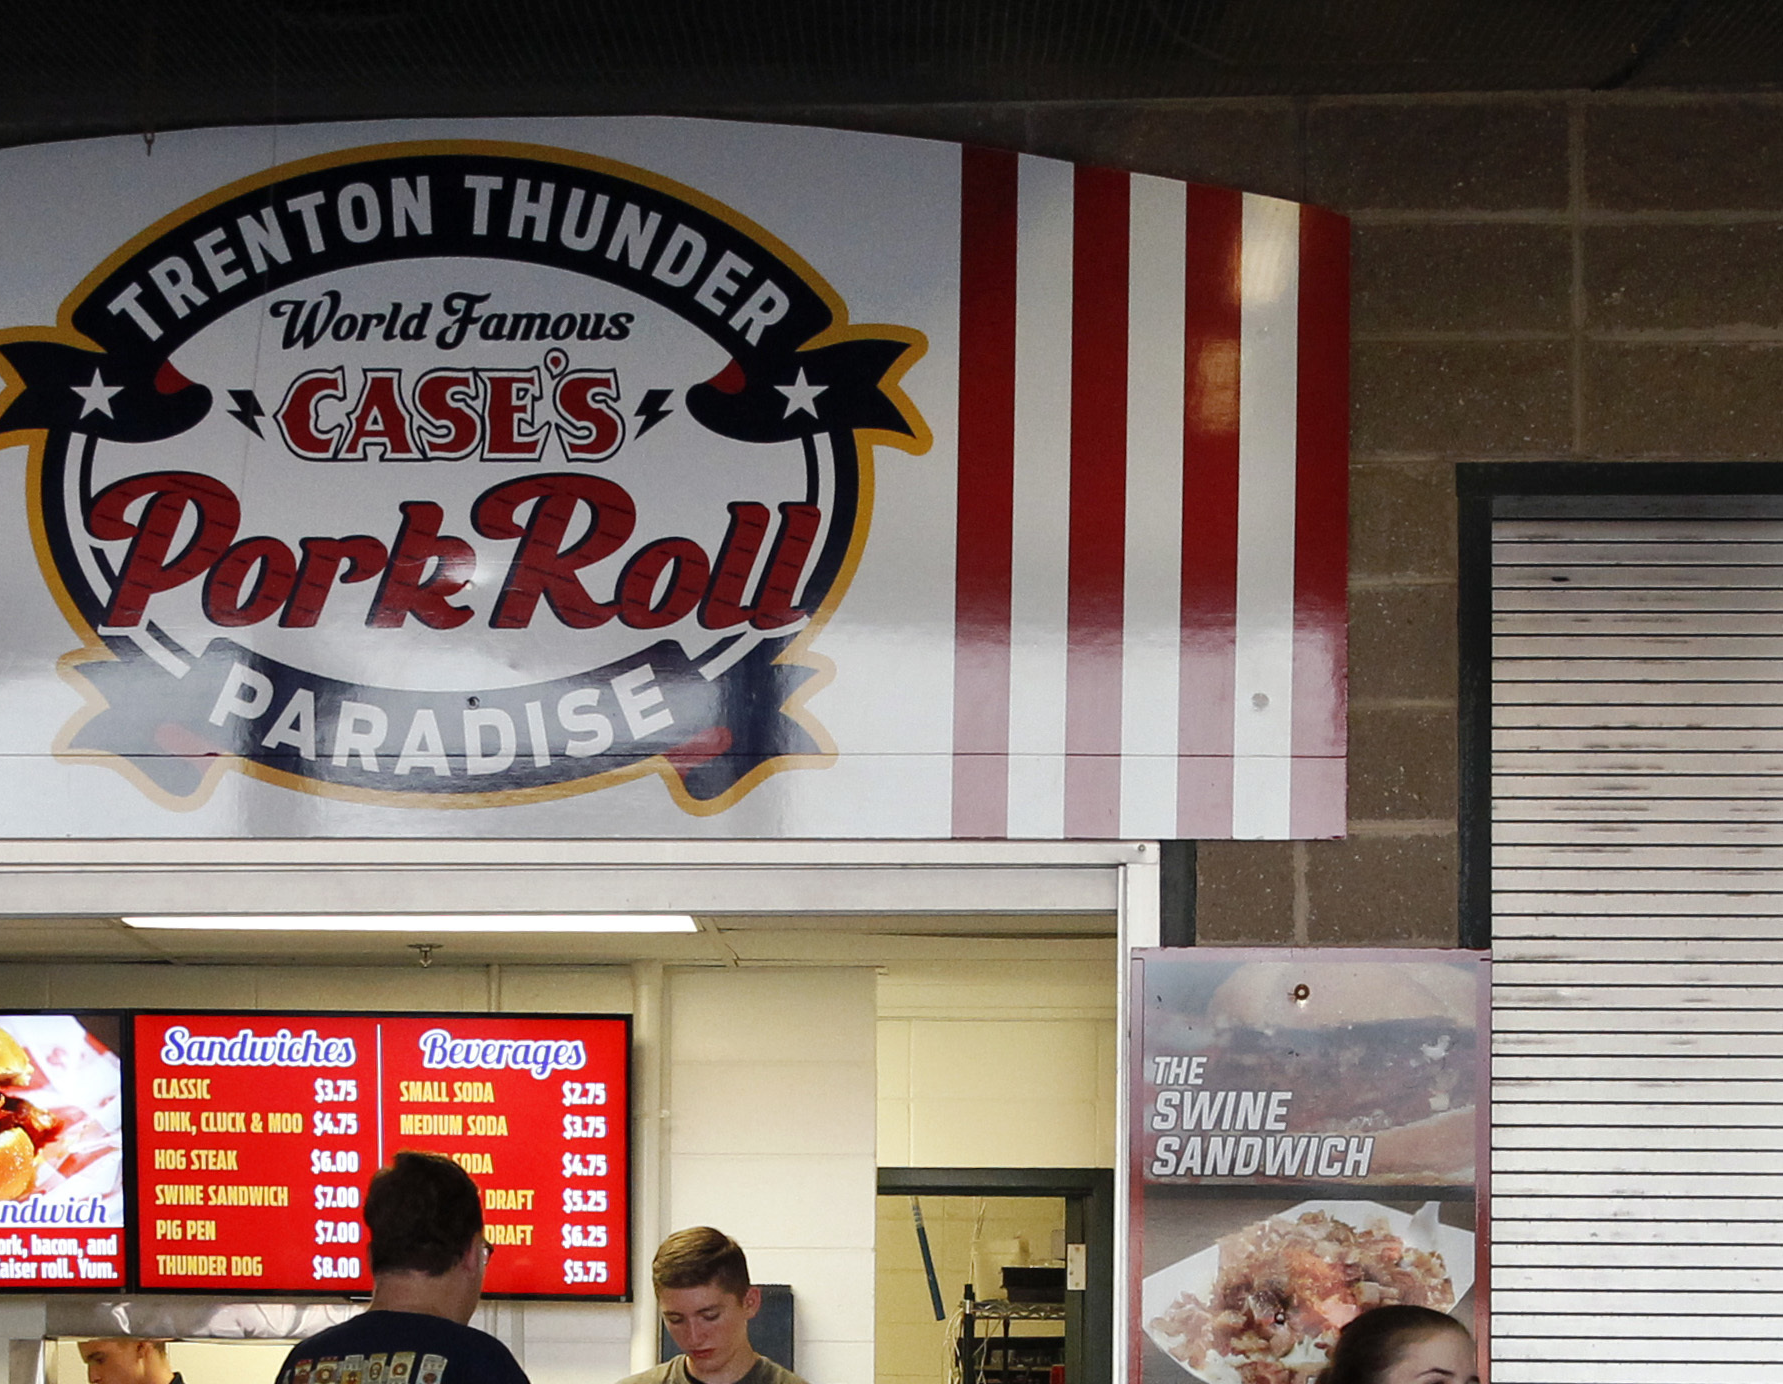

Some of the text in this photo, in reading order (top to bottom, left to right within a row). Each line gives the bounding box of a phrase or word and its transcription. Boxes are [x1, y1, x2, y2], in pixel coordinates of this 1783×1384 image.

[107, 173, 792, 345] TRENTON THUNDER
[269, 287, 636, 351] World Famous
[272, 346, 628, 464] CASE'S
[88, 470, 823, 633] Pork Roll
[208, 662, 675, 778] PARADISE
[163, 1028, 354, 1065] Sandwiches
[421, 1031, 584, 1077] Beverages
[1152, 1055, 1207, 1086] THE
[153, 1078, 358, 1103] CLASSIC $3.75
[400, 1081, 606, 1107] SMALL SODA $2.75
[153, 1111, 358, 1136] OINK, CLUCK & MOO $4.75
[1151, 1090, 1293, 1131] SWINE
[400, 1114, 607, 1140] MEDIUM SODA $3.75
[154, 1149, 359, 1174] HOG STEAK $6.00
[562, 1152, 607, 1178] $4.75
[1151, 1135, 1375, 1178] SANDWICH
[155, 1184, 359, 1210] SWINE SANDWICH $7.00
[485, 1188, 608, 1214] DRAFT $5.25
[156, 1219, 360, 1245] PIG PEN $7.00
[484, 1223, 607, 1249] DRAFT $6.25
[30, 1234, 84, 1258] bacon,
[86, 1234, 117, 1256] and
[41, 1258, 74, 1279] roll.
[77, 1258, 118, 1279] Yum.
[156, 1255, 360, 1280] THUNDER DOG $8.00
[563, 1258, 608, 1284] $5.75
